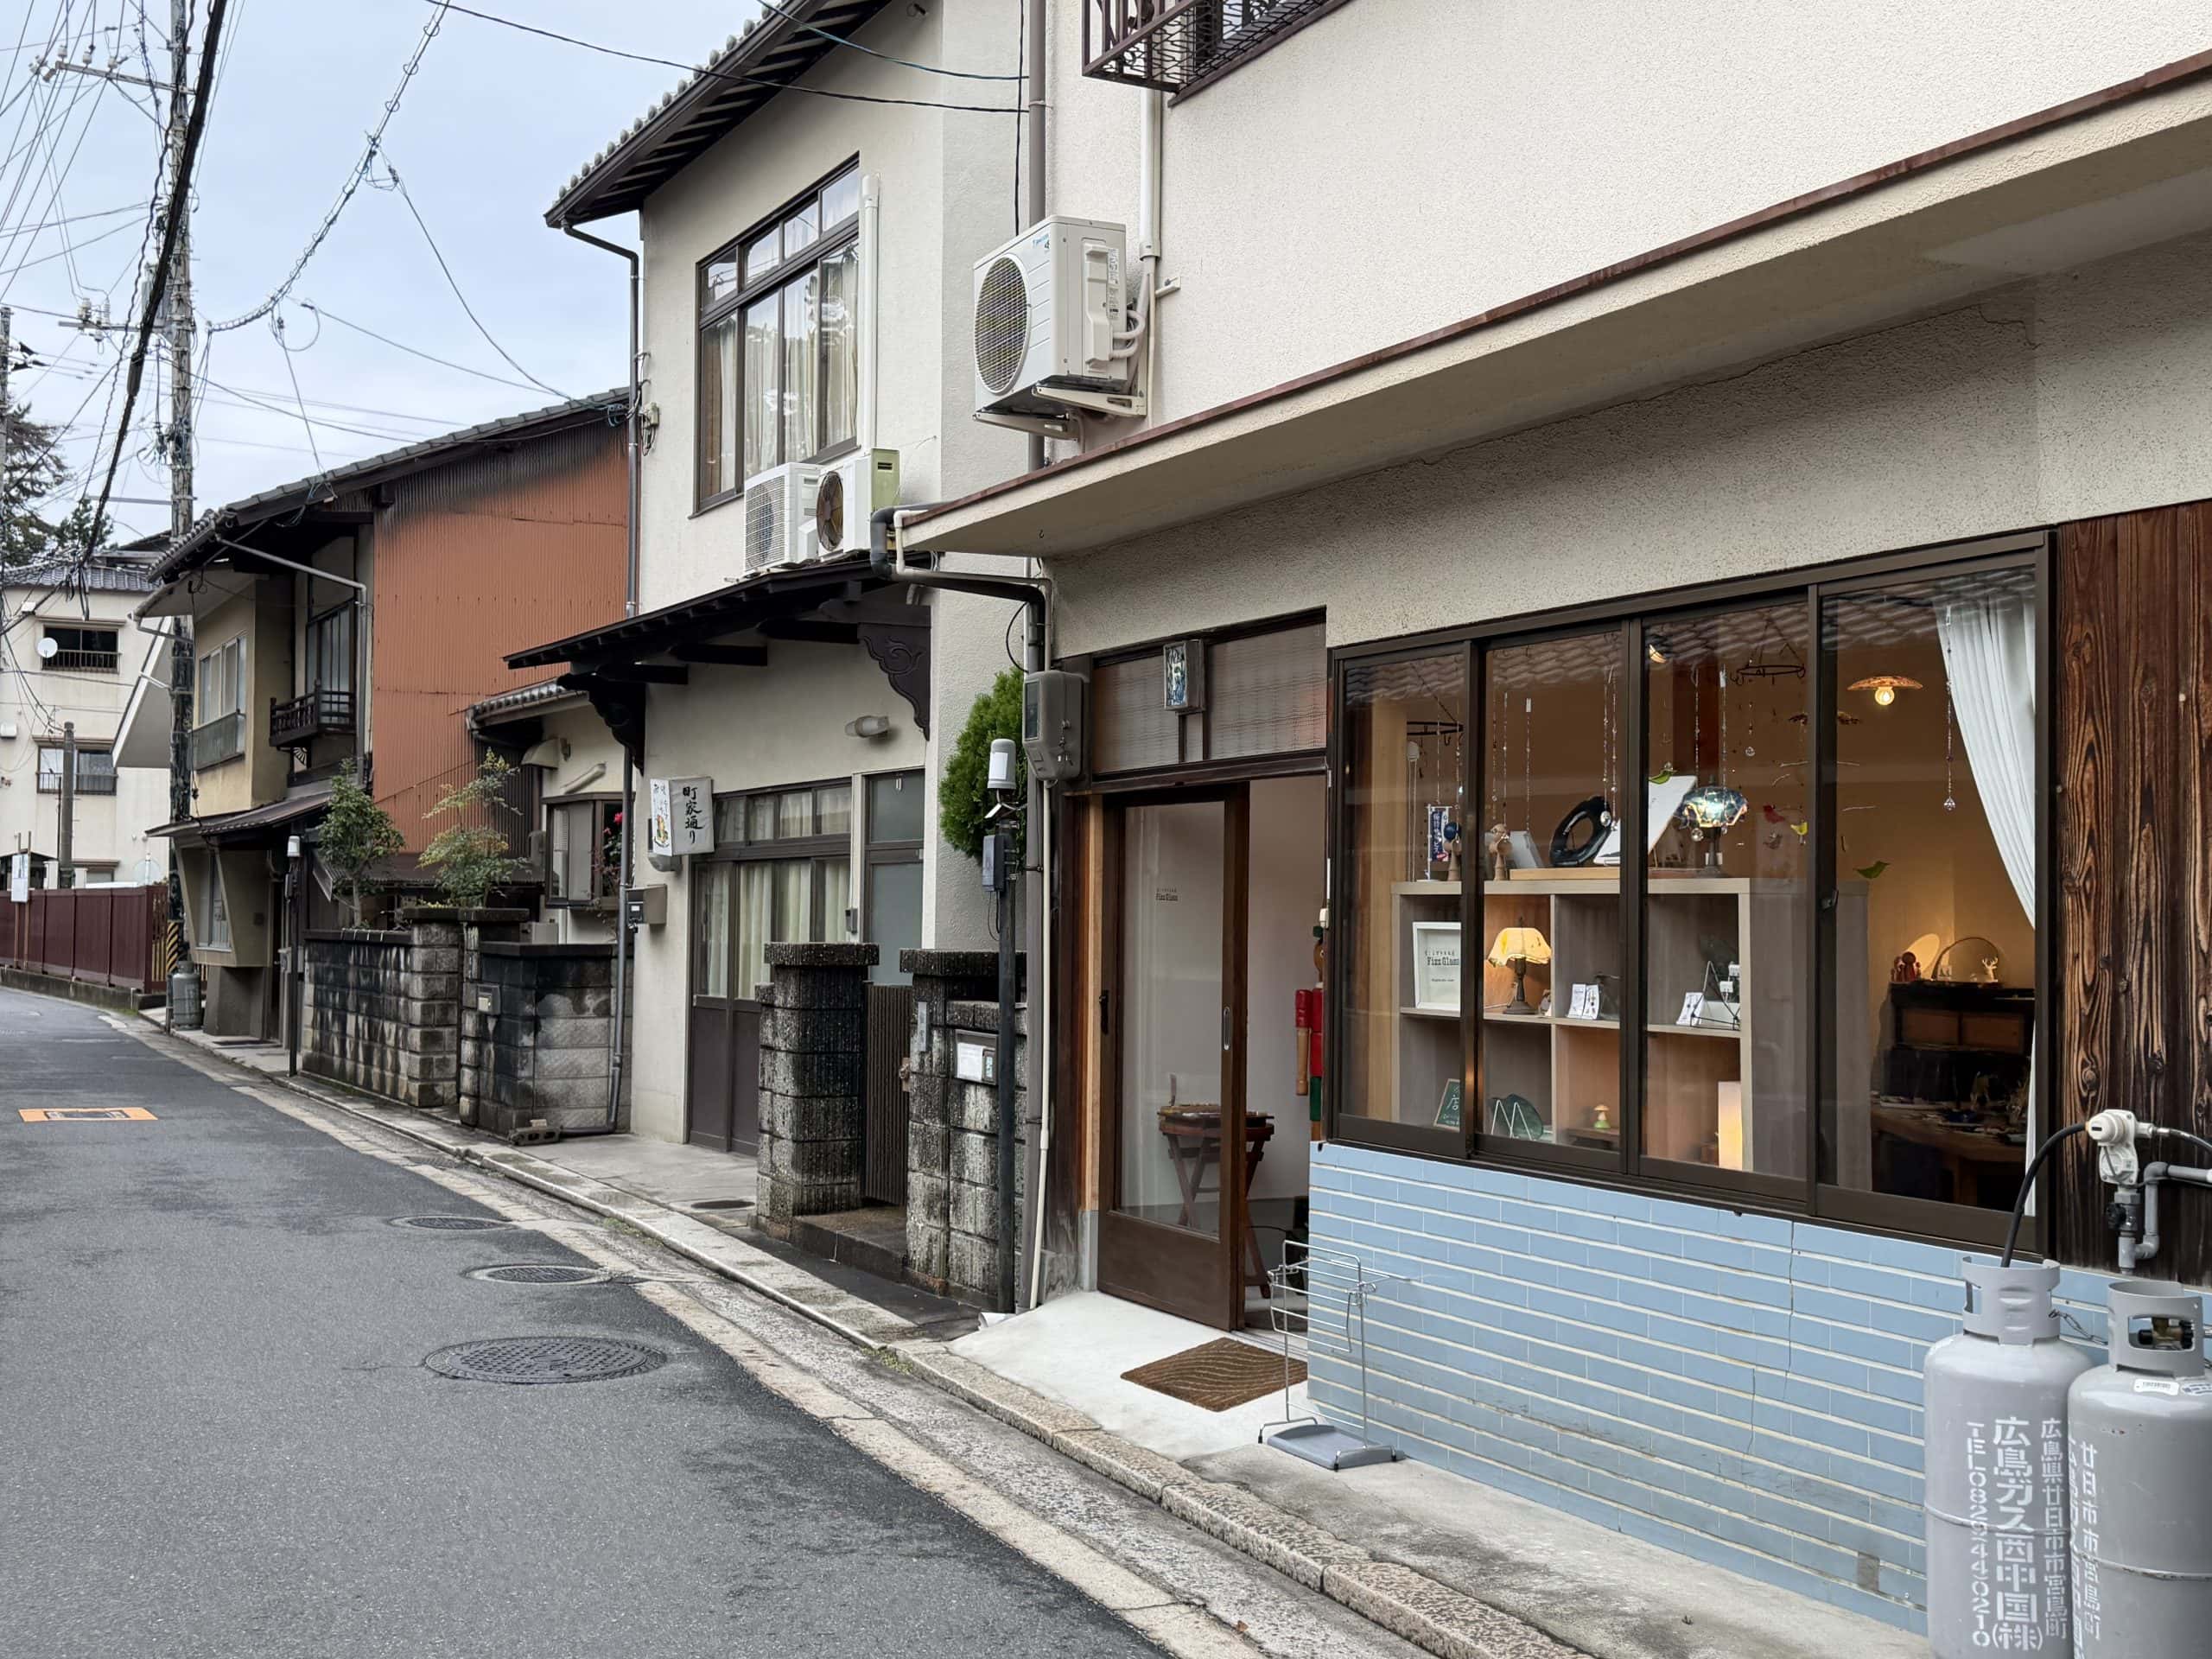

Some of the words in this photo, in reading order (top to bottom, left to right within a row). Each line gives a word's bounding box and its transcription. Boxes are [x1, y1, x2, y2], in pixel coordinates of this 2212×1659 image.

[683, 786, 704, 844] 町家通り
[1993, 1415, 2044, 1651] 広島ガス西中国(株)
[2040, 1417, 2068, 1639] 広島県廿日市市宮島町
